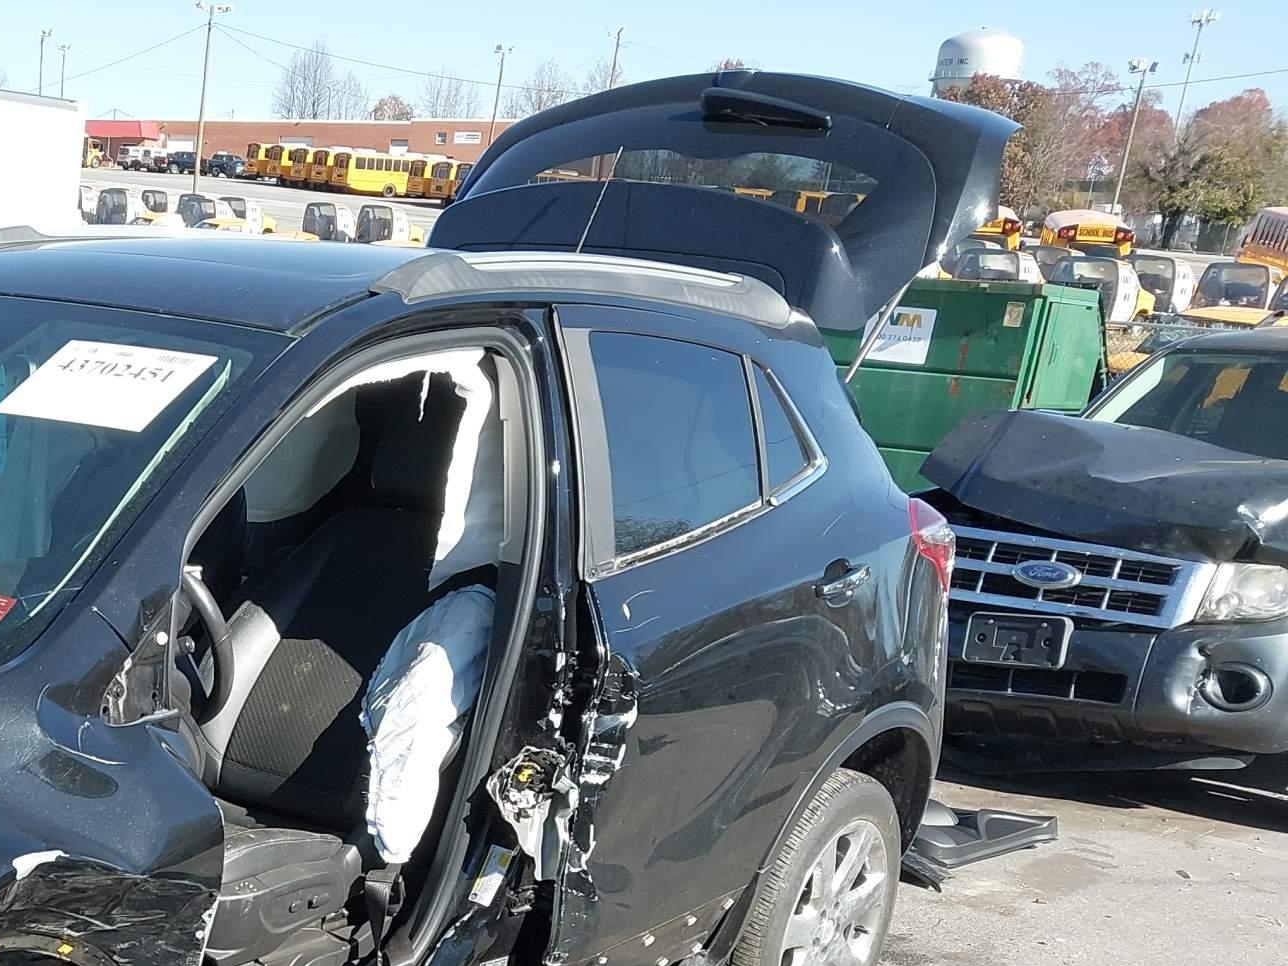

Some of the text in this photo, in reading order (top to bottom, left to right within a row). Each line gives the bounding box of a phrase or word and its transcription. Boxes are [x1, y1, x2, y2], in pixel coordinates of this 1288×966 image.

[1078, 228, 1114, 238] SCHOOL BUS
[58, 358, 175, 383] 43702451
[1028, 566, 1060, 579] Ford
